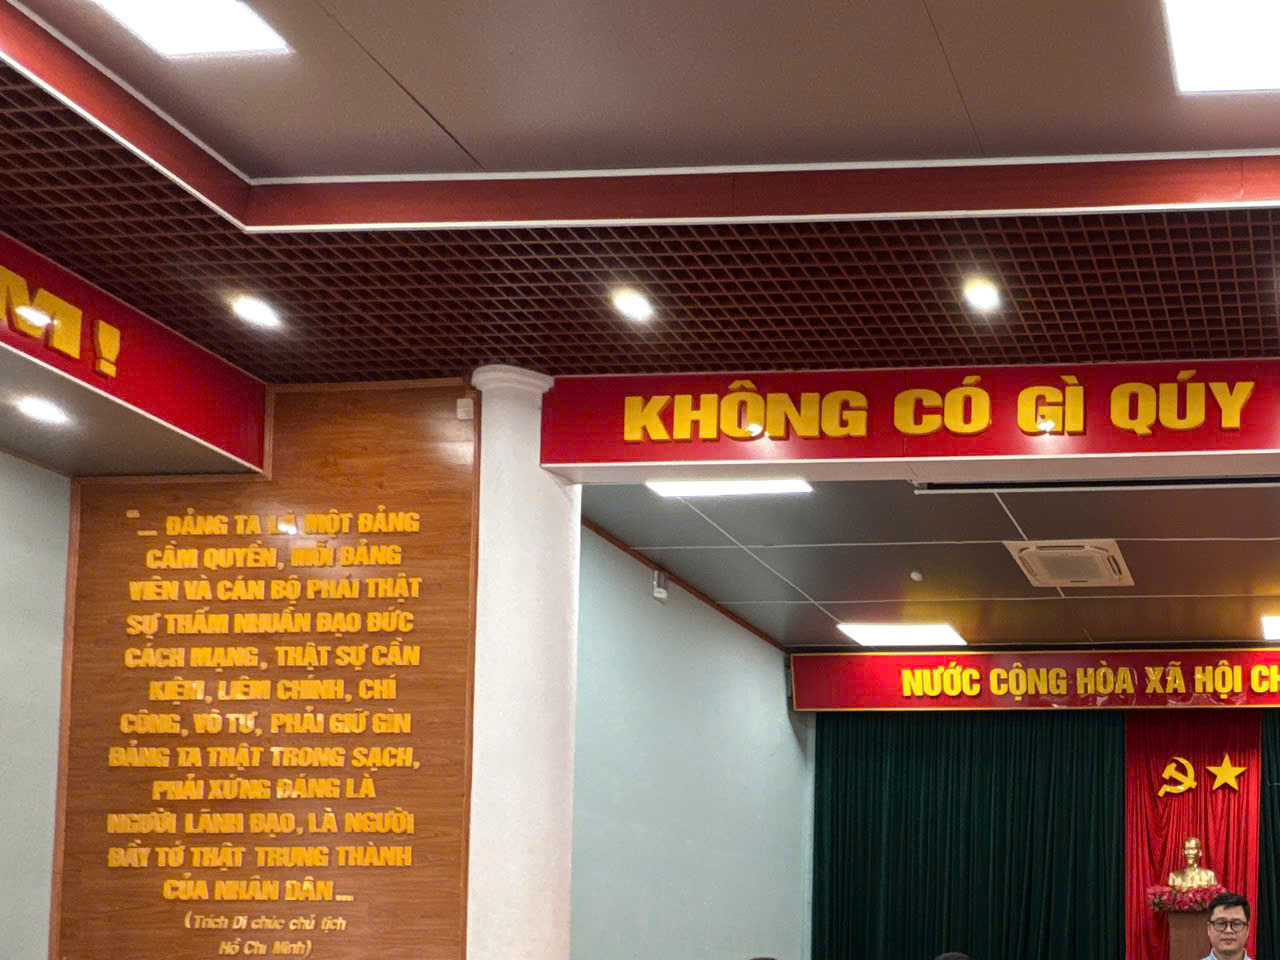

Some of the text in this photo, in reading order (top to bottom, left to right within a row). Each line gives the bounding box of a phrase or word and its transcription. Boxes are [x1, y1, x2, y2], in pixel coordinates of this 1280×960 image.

[623, 381, 868, 443] KHÔNG
[893, 375, 992, 436] CÓ
[1017, 375, 1086, 436] GÌ
[126, 611, 162, 640] SỰ
[275, 641, 331, 671] THẬT
[334, 644, 369, 671] SỰ
[901, 663, 981, 697] NƯỚC
[989, 662, 1069, 701] CỘNG
[1076, 660, 1133, 695] HÒA
[1144, 661, 1187, 694] XÃ
[1194, 659, 1244, 699] HỘI
[176, 746, 203, 767] TA
[206, 743, 264, 771] THẬT
[269, 746, 345, 768] TRONG
[308, 808, 338, 834] LÀ
